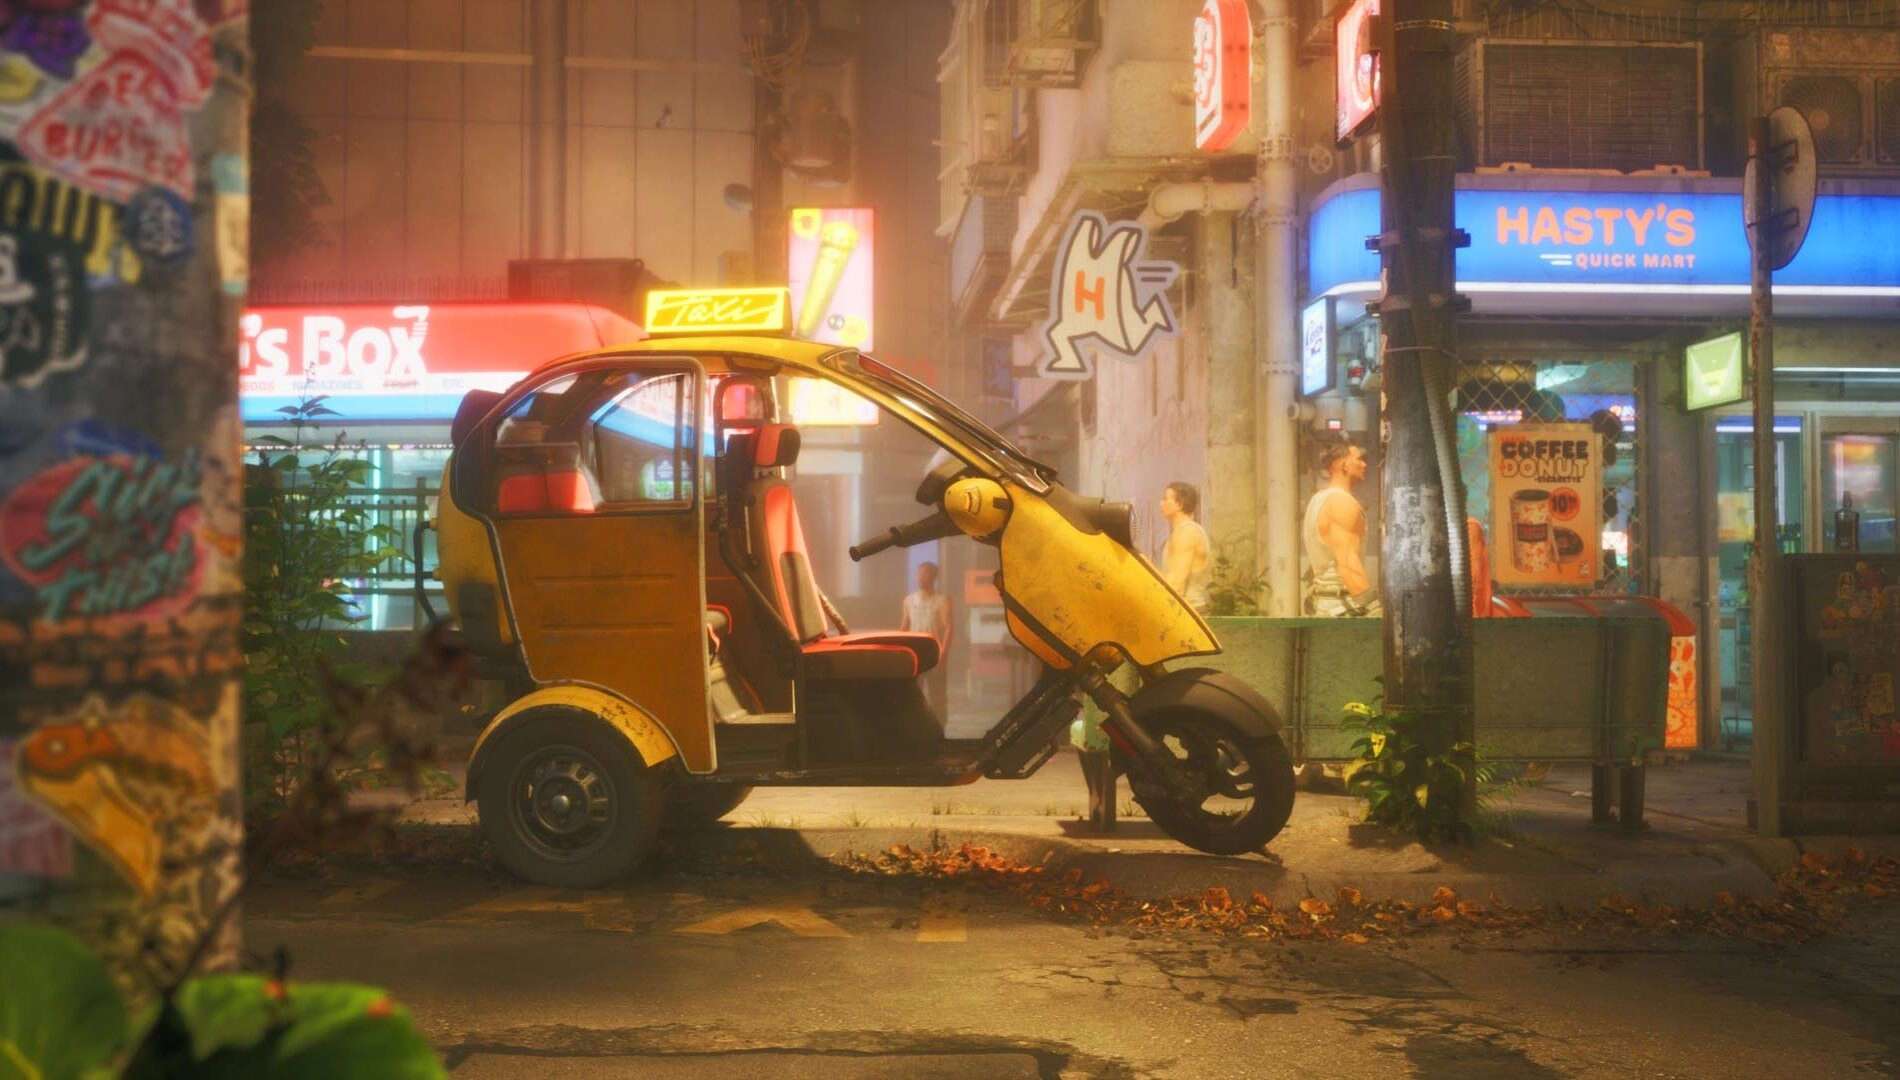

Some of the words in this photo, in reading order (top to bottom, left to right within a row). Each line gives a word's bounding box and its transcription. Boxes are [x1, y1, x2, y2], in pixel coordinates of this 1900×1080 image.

[1497, 203, 1696, 246] HASTY'S
[1576, 253, 1637, 269] QUICK
[1643, 253, 1697, 269] MART
[662, 295, 762, 328] Taxi
[1074, 270, 1105, 321] H
[303, 306, 430, 376] Box
[1501, 440, 1589, 459] COFFEE
[1501, 457, 1589, 478] DONUT
